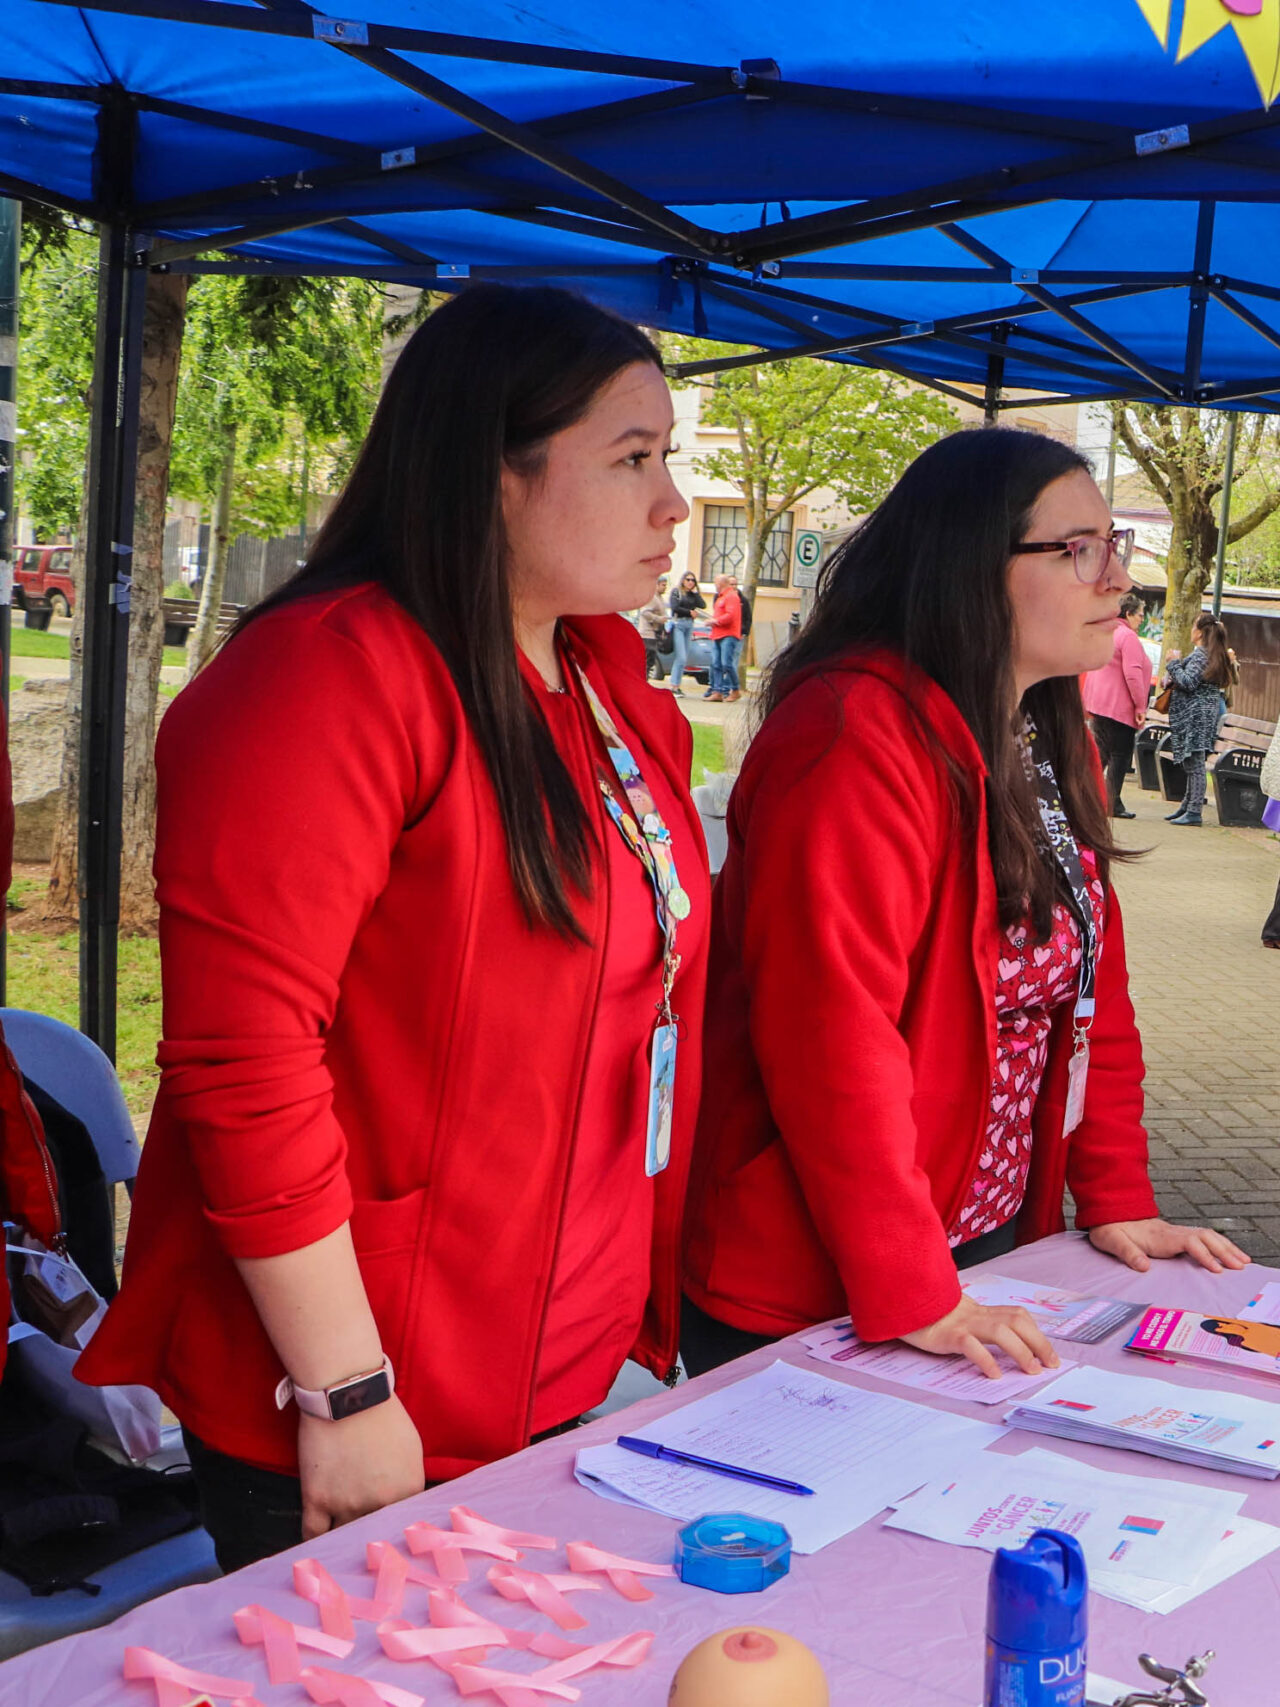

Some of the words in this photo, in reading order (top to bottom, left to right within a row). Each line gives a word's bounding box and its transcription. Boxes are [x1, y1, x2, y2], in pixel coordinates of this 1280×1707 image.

[803, 540, 813, 560] E
[965, 1507, 1002, 1538] JUNTOS
[997, 1495, 1040, 1531] CÁNCER
